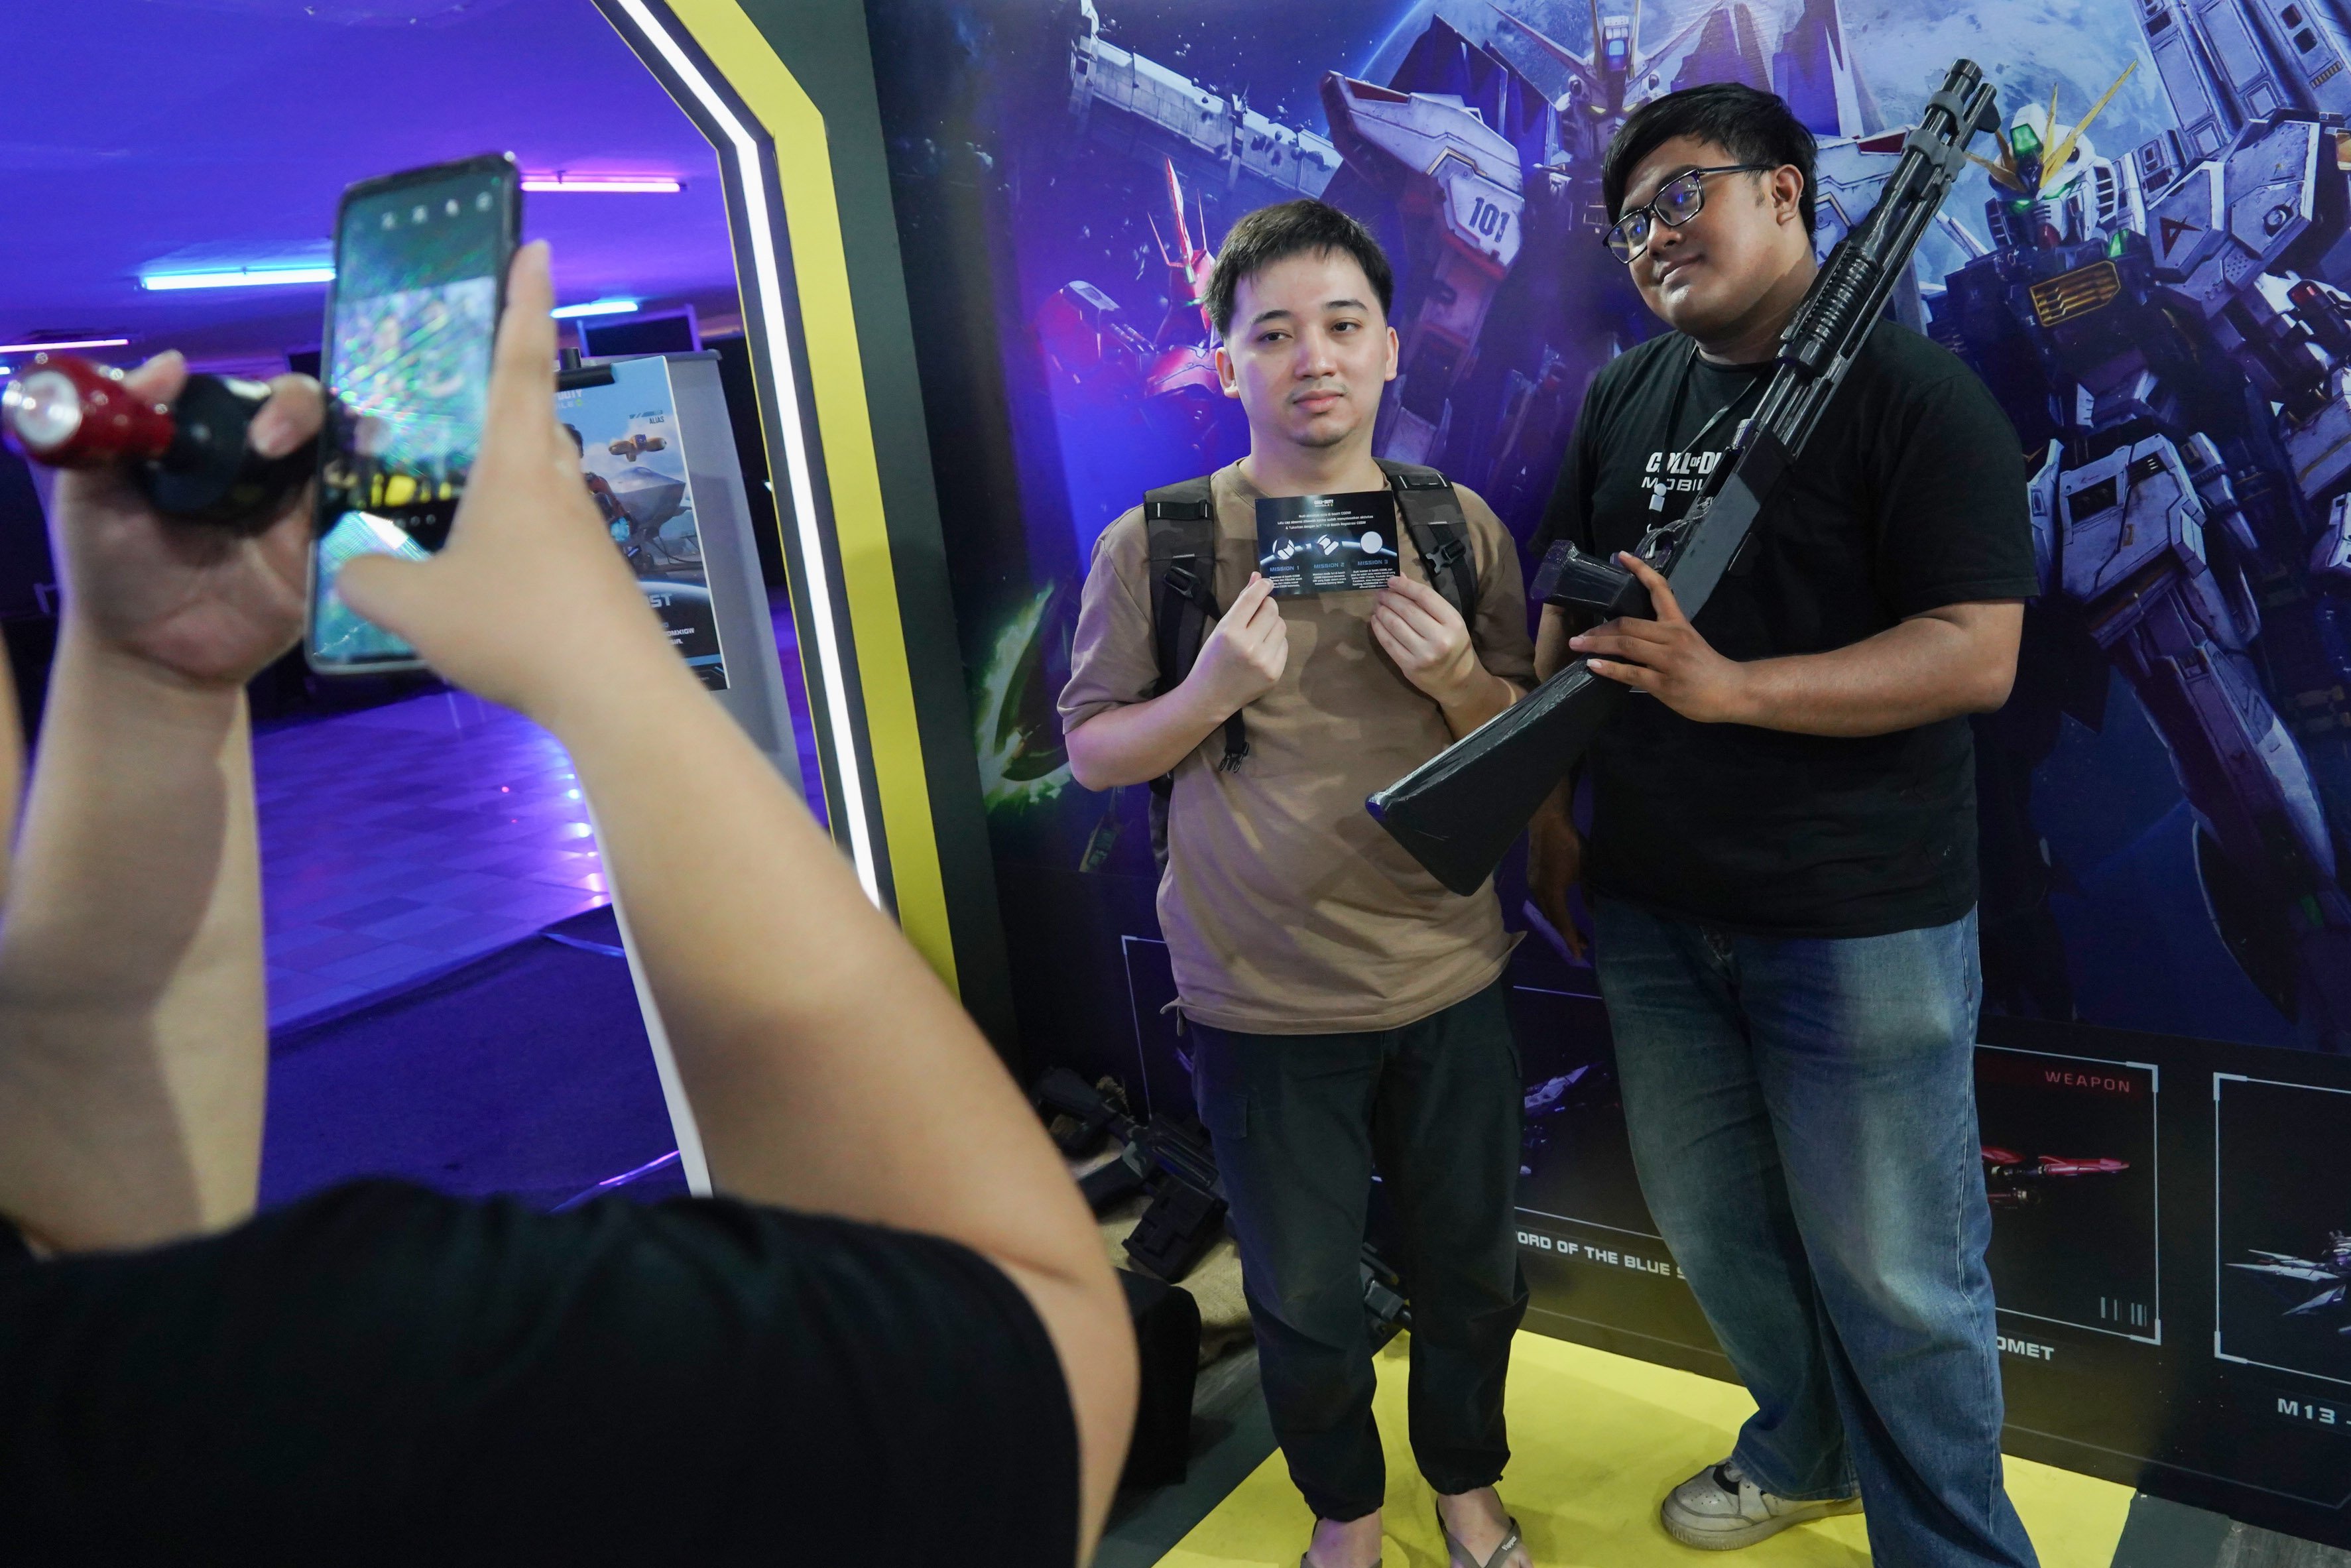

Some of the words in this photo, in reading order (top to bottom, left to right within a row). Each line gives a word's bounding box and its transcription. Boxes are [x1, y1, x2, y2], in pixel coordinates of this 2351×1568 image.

[1469, 196, 1510, 243] 101
[1641, 476, 1703, 492] MOBIL
[650, 593, 672, 608] ST
[2045, 1071, 2130, 1093] WEAPON
[1516, 1231, 1551, 1250] ORD
[1557, 1240, 1579, 1254] OF
[1584, 1245, 1618, 1265] THE
[1624, 1255, 1670, 1276] BLUE
[2277, 1398, 2335, 1425] M13
